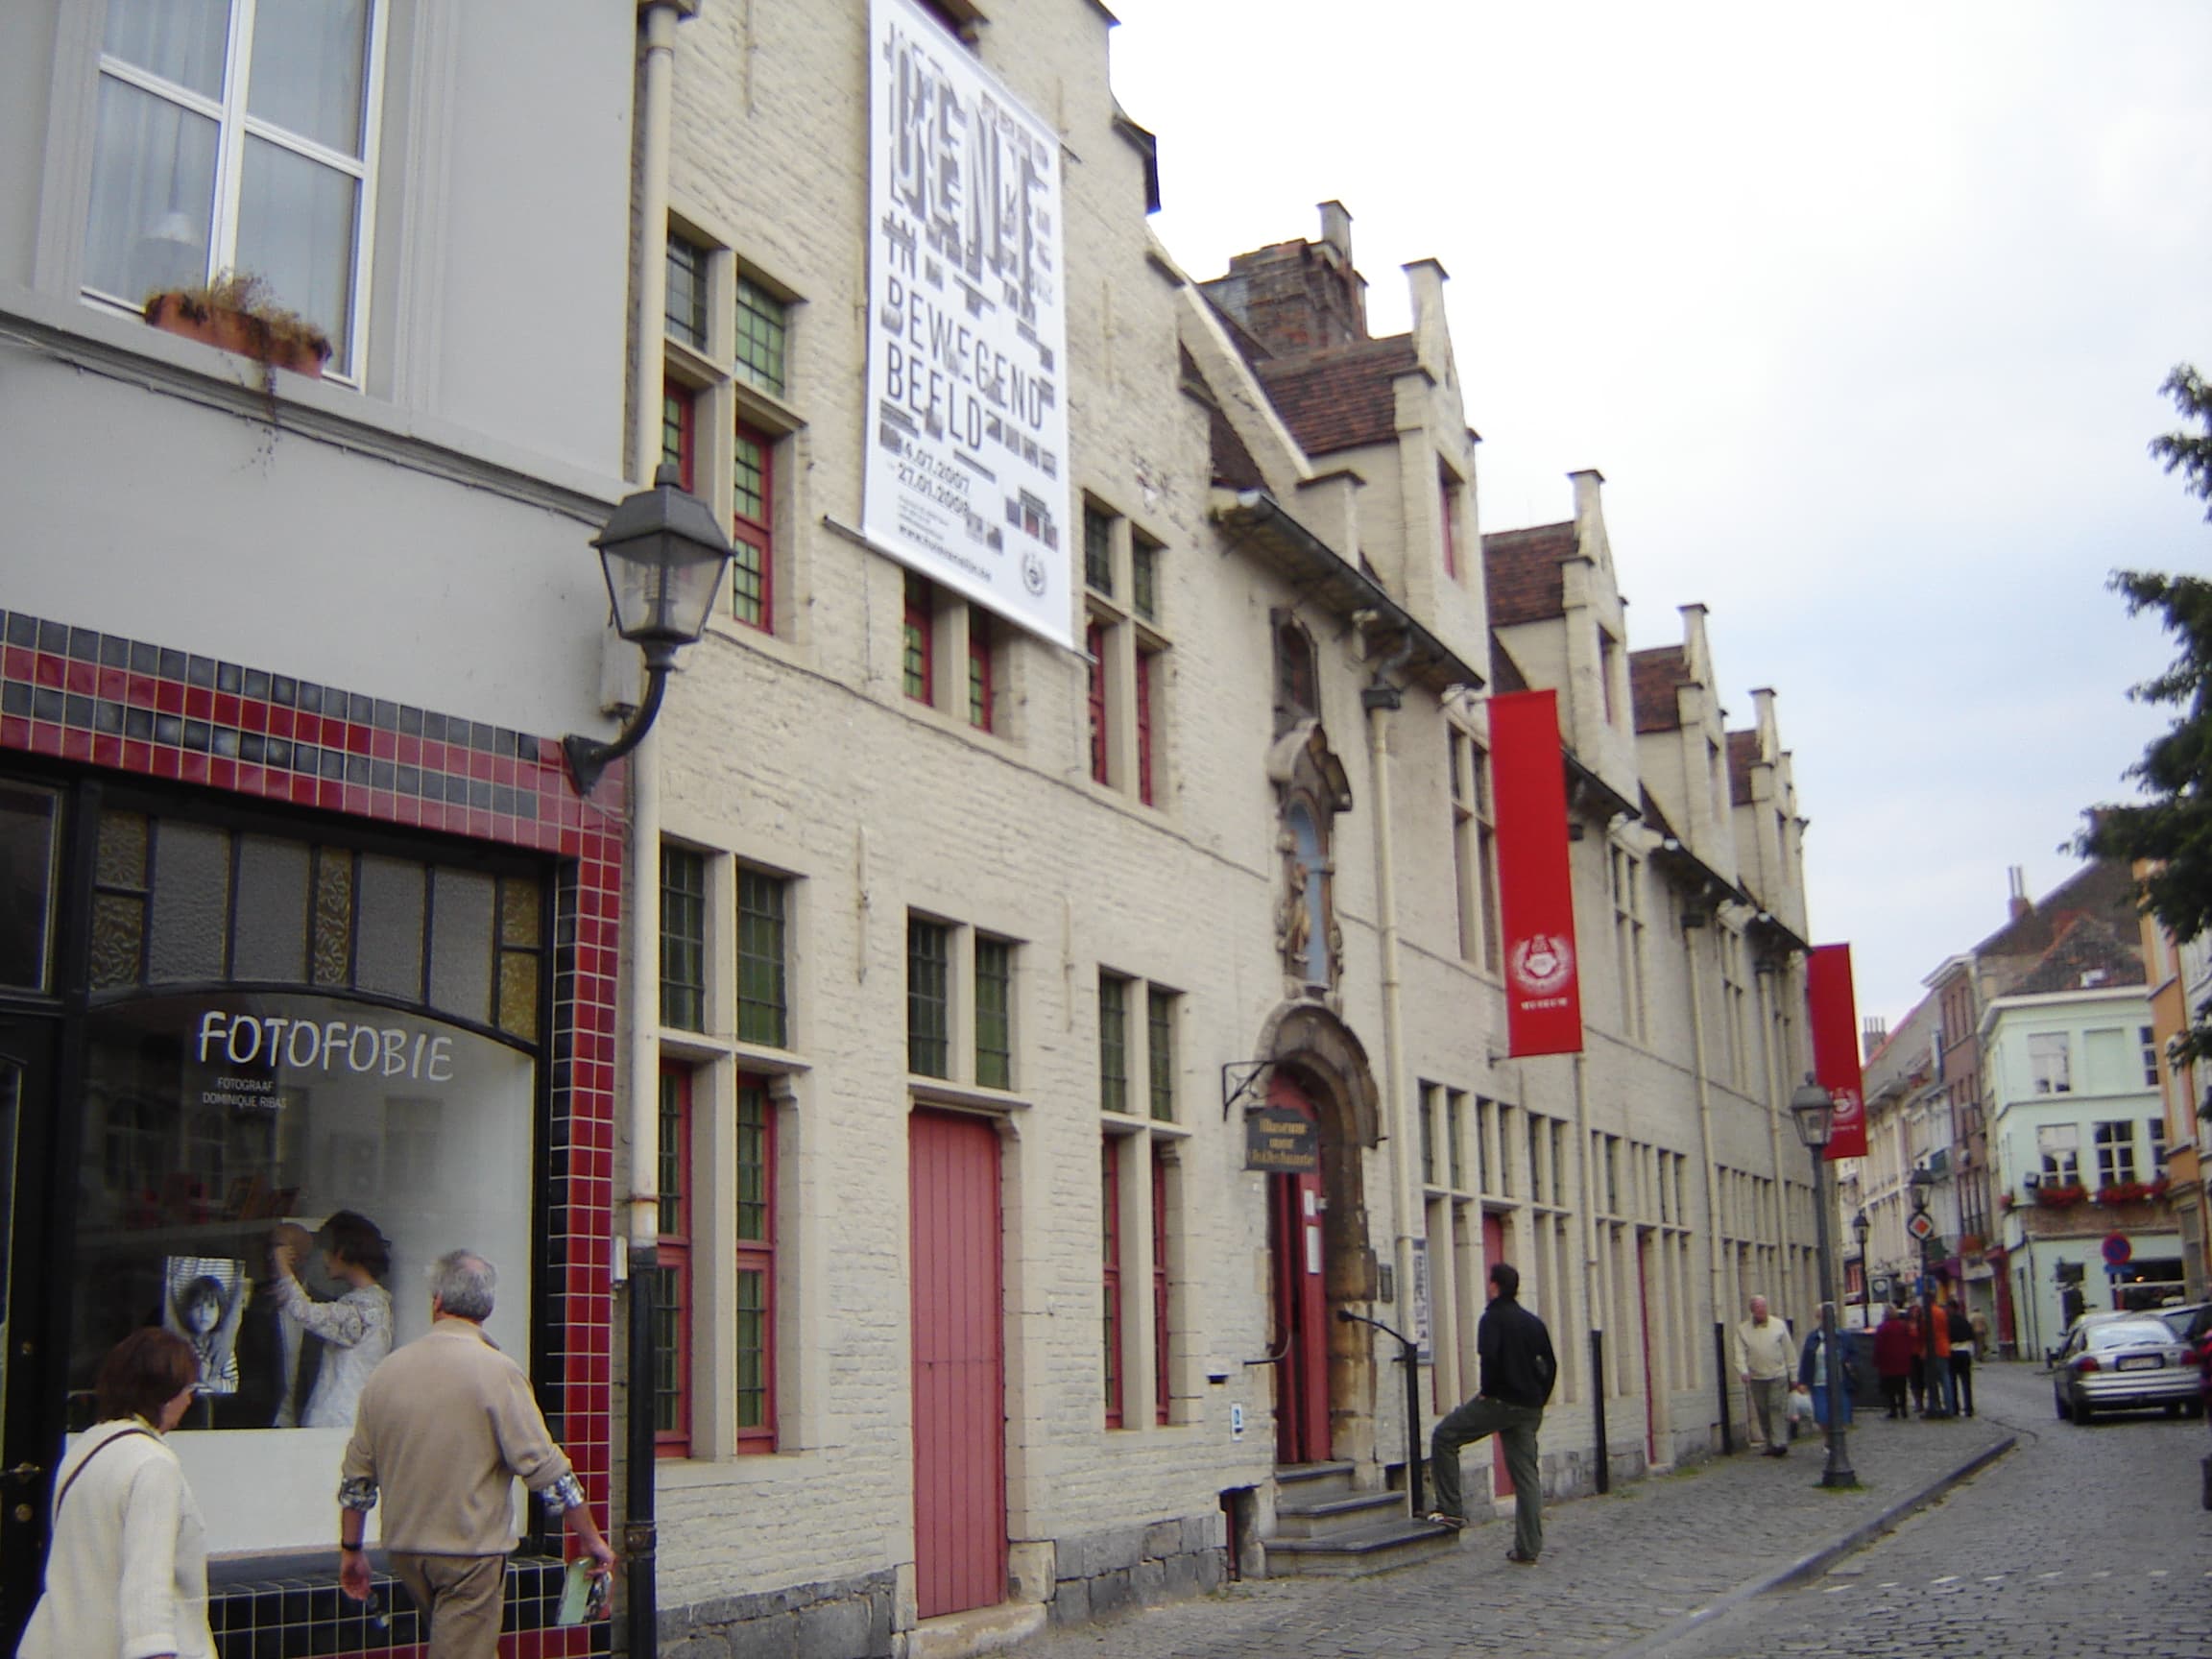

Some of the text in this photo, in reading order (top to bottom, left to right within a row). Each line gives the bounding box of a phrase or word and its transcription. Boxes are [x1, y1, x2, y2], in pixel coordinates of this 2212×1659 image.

[889, 276, 1043, 430] BEWEGEND
[887, 341, 982, 452] BEELD
[199, 1011, 454, 1081] FOTOFOBIE
[203, 1092, 257, 1109] DOMINIQUE
[217, 1077, 275, 1092] FOTOGRAAF
